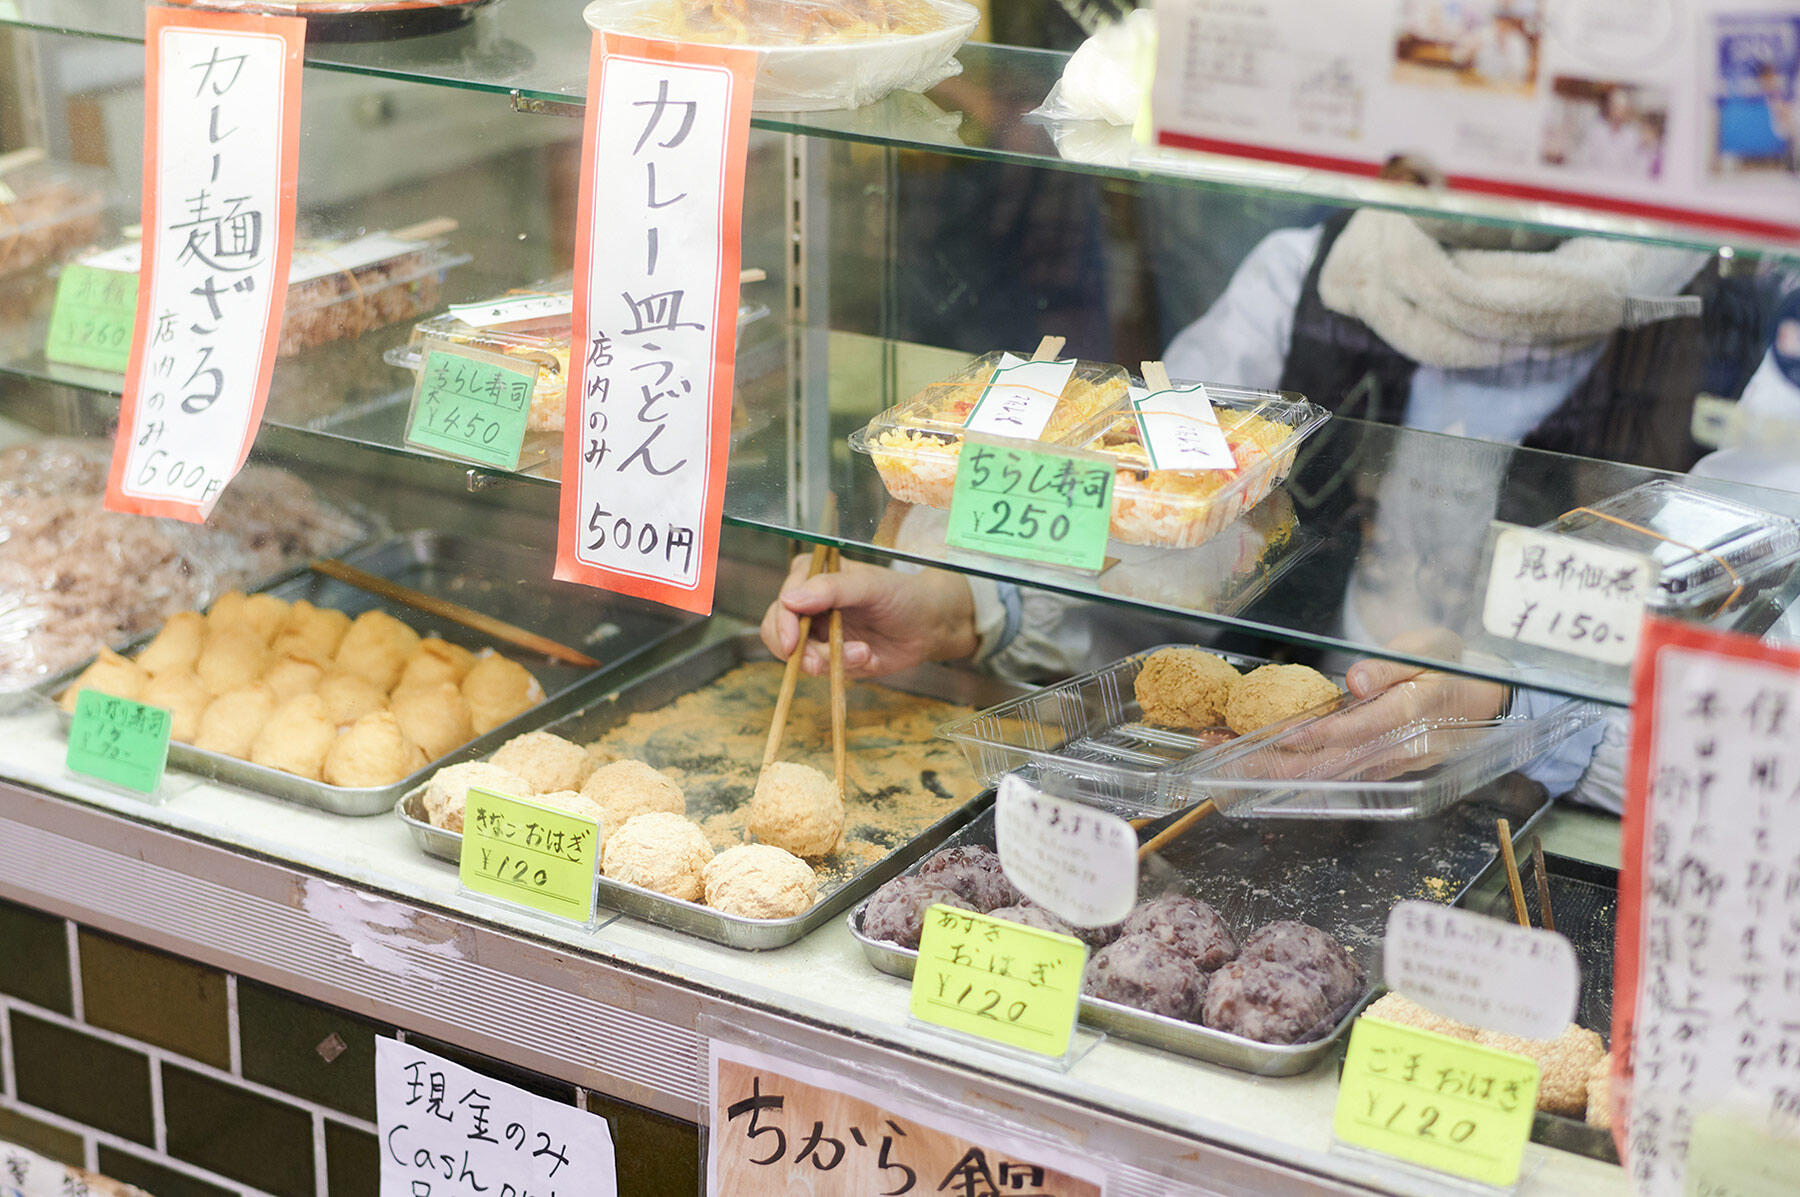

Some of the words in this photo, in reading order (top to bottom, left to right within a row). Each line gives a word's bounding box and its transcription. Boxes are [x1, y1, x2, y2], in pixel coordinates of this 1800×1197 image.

[168, 46, 267, 415] カレー麺ざる
[616, 79, 707, 477] カレー皿うどん
[139, 308, 180, 447] 店内のみ
[433, 360, 529, 411] ちらし寿司
[584, 330, 615, 471] 店内のみ
[969, 448, 1111, 509] ちらし寿司
[586, 501, 695, 575] 500円
[476, 806, 591, 863] きなこおはぎ
[481, 846, 548, 887] ¥120
[950, 943, 1062, 988] おはぎ
[403, 1060, 570, 1178] 現金のみ
[387, 1123, 490, 1192] Cash
